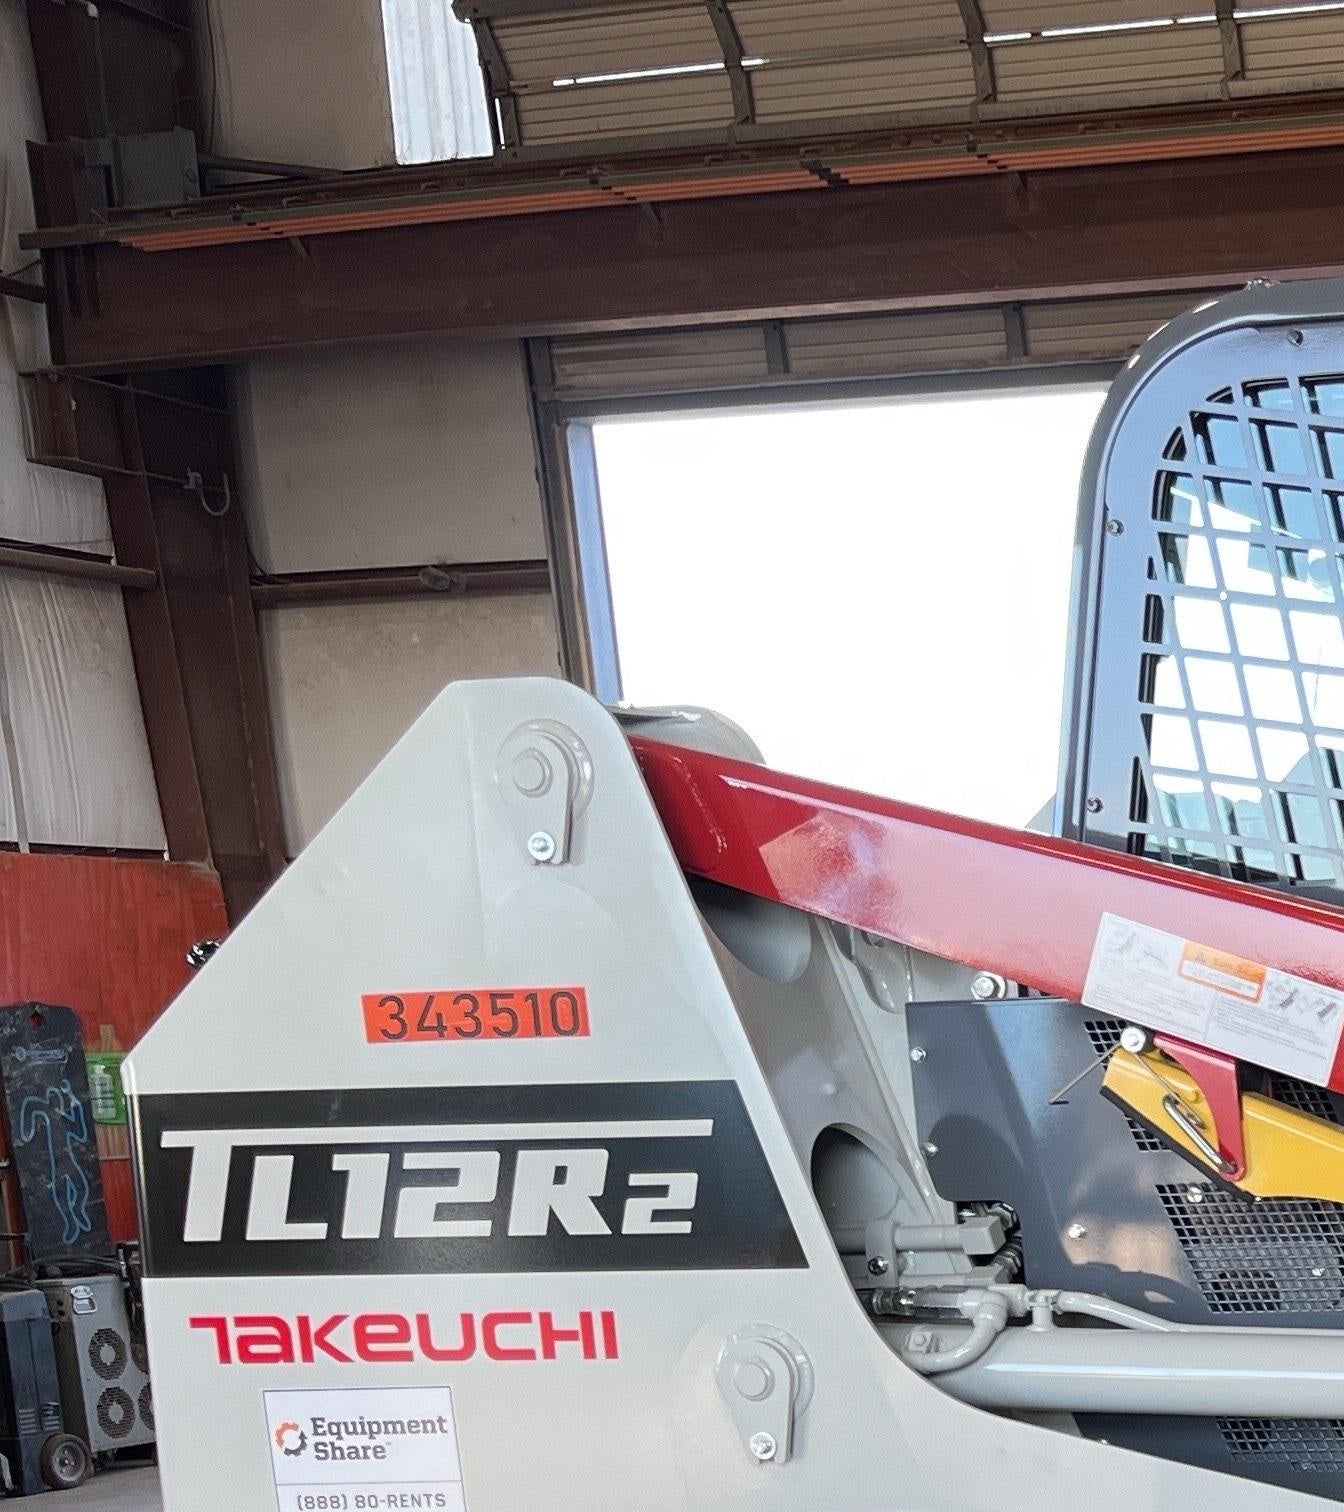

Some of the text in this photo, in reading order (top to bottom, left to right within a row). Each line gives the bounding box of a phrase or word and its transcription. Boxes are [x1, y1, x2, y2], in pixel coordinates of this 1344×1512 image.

[378, 991, 581, 1040] 343510
[160, 1119, 714, 1242] TL12R2
[188, 1310, 619, 1365] TAKEUCHI
[310, 1415, 449, 1441] Equipment
[313, 1442, 388, 1461] Share
[297, 1493, 447, 1511] (888) 80-RENTS
